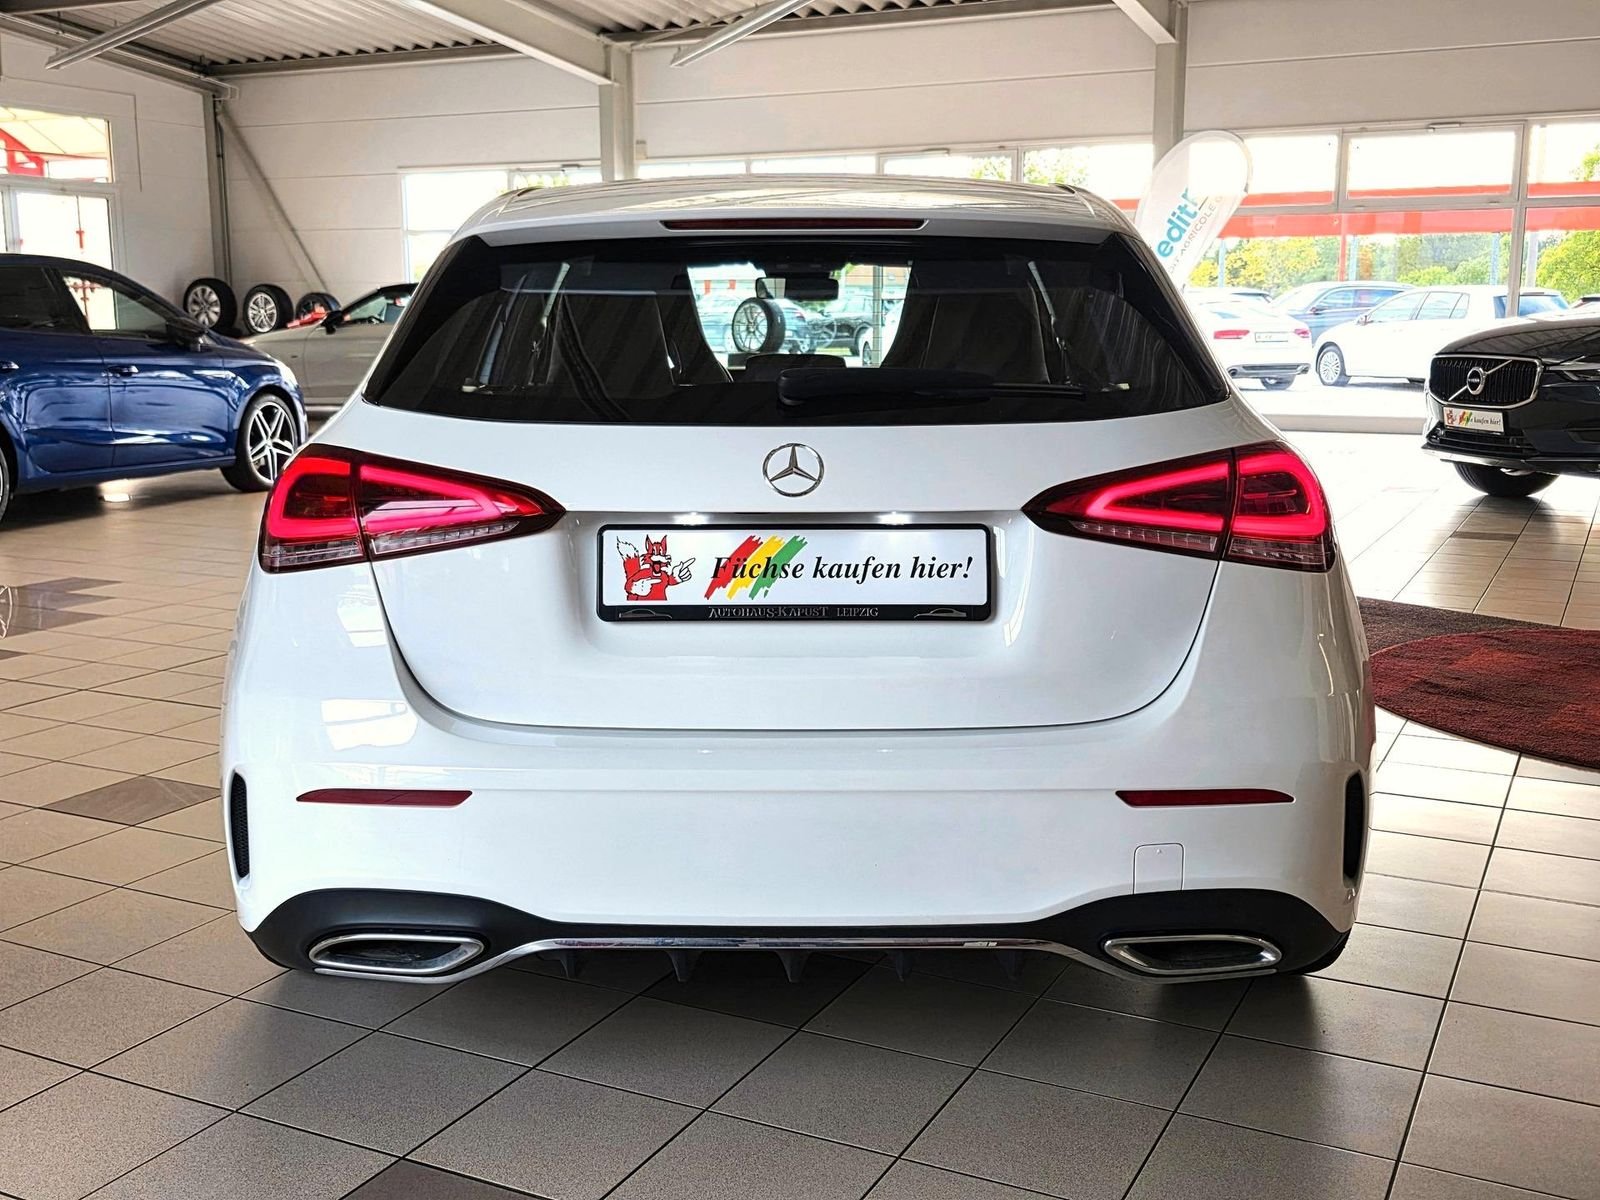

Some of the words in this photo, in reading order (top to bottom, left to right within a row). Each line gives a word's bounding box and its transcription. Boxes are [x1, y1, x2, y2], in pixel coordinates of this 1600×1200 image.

[710, 556, 805, 579] Füchse
[812, 556, 901, 585] kaufen
[910, 556, 973, 579] hier!
[836, 607, 879, 618] LEIPZIG
